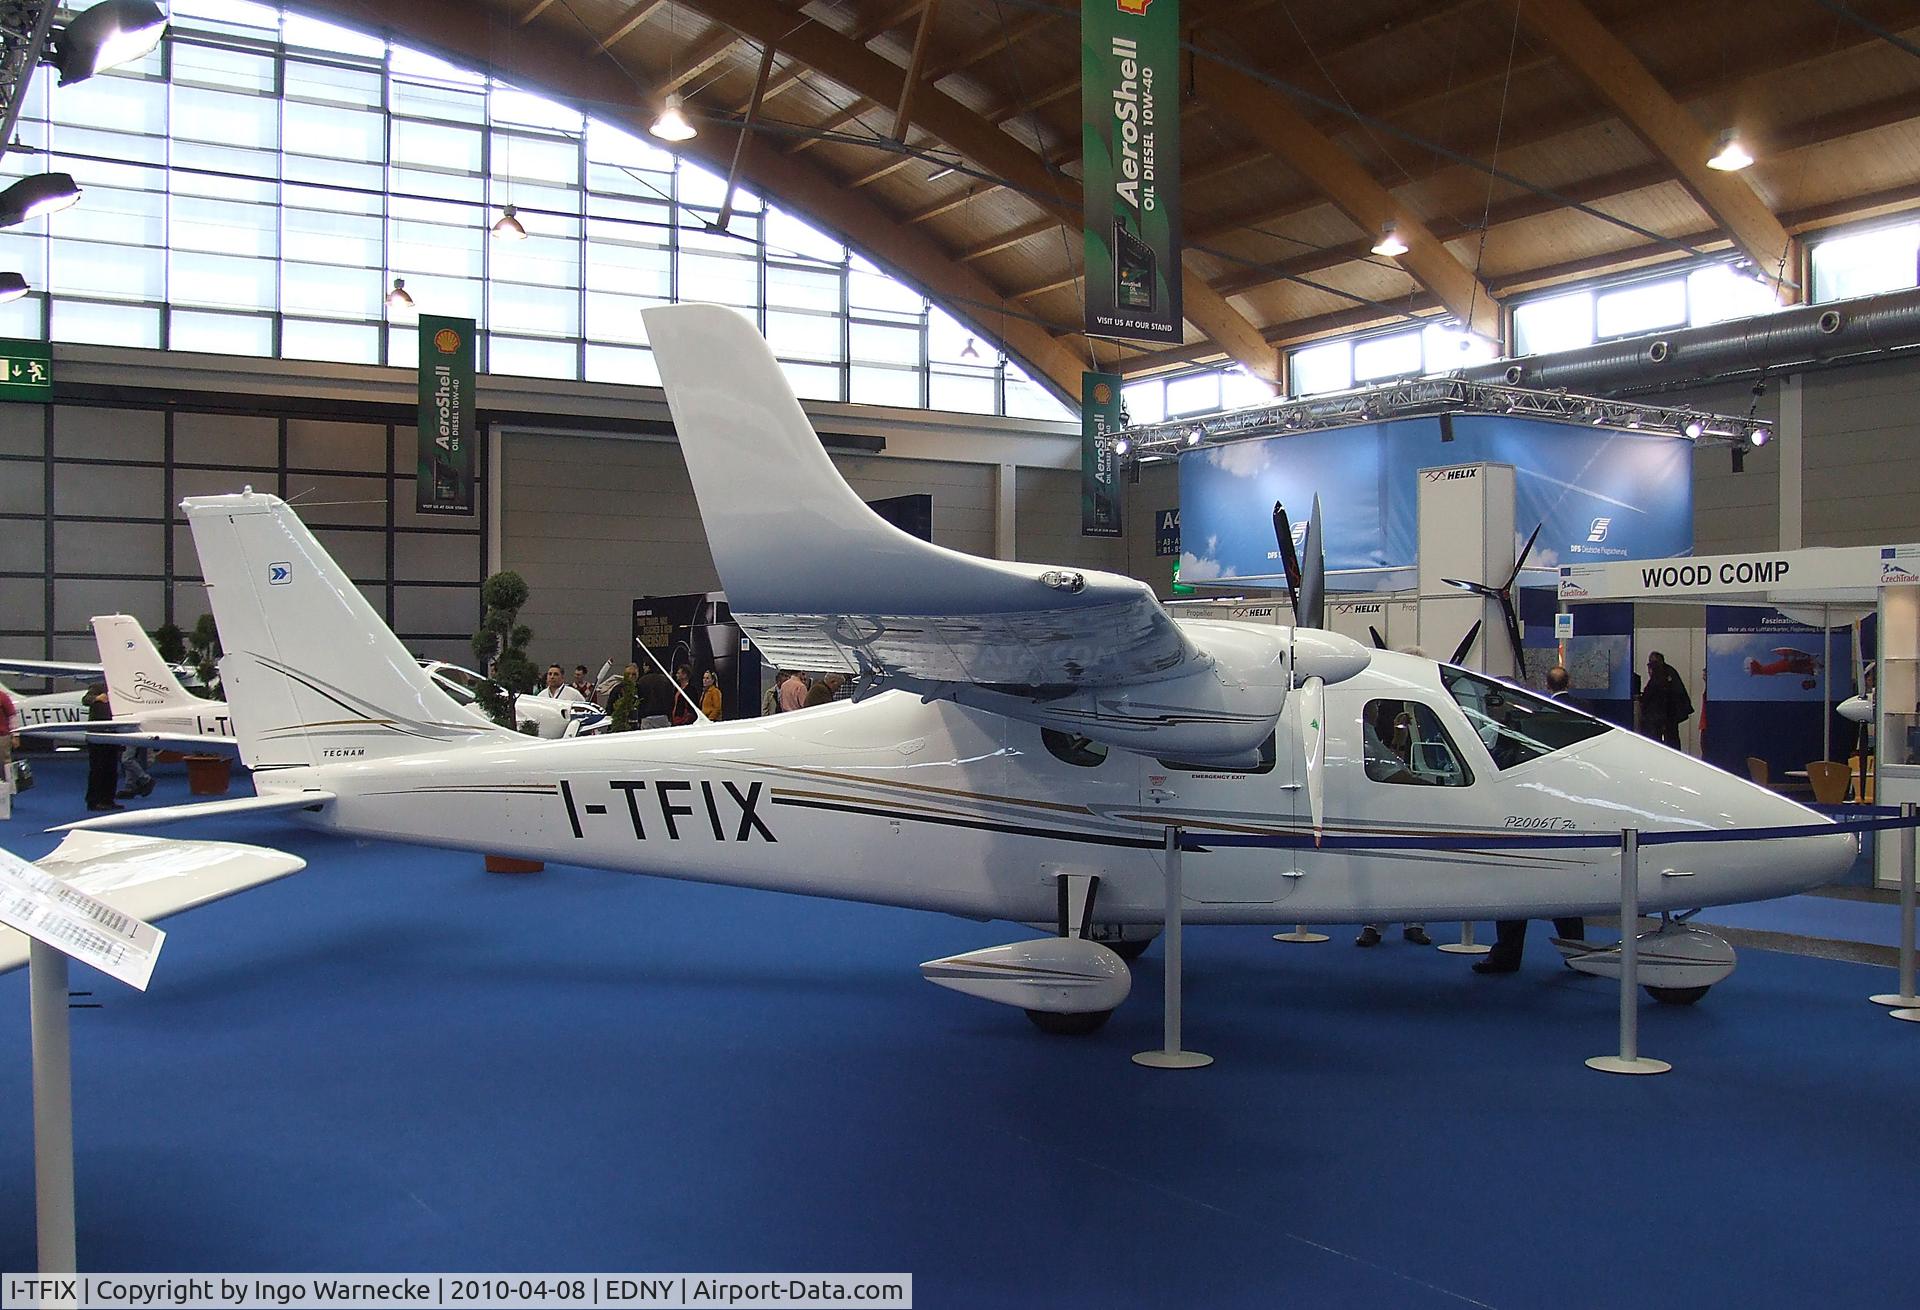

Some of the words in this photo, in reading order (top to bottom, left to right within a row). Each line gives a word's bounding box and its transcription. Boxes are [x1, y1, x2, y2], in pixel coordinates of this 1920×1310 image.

[1142, 67, 1153, 126] 10W-40
[1112, 36, 1138, 209] AeroShell
[1143, 132, 1154, 182] DIESEL
[1143, 184, 1155, 211] OIL
[1097, 316, 1113, 326] VISIT
[1114, 318, 1124, 327] US
[1125, 320, 1134, 328] AT
[1134, 321, 1150, 330] OUR
[1150, 323, 1173, 332] STAND
[452, 379, 460, 409] 10W-40
[435, 366, 450, 450] AeroShell
[452, 410, 460, 436] DIESEL
[1094, 414, 1105, 483] AeroShell
[1447, 468, 1477, 480] HELIX
[1162, 538, 1181, 546] A3-A
[1570, 544, 1581, 553] DFS
[1641, 565, 1712, 588] WOOD
[1719, 560, 1790, 584] COMP
[1880, 574, 1920, 583] CzechTrade
[1560, 589, 1589, 598] CzechTrade
[1186, 609, 1213, 618] Propeller
[1249, 608, 1272, 617] HELIX
[1354, 604, 1381, 614] HELIX
[133, 671, 170, 691] Sierra
[323, 749, 365, 757] TECNAM
[560, 779, 778, 843] I-TFIX
[1504, 815, 1562, 829] P2006T
